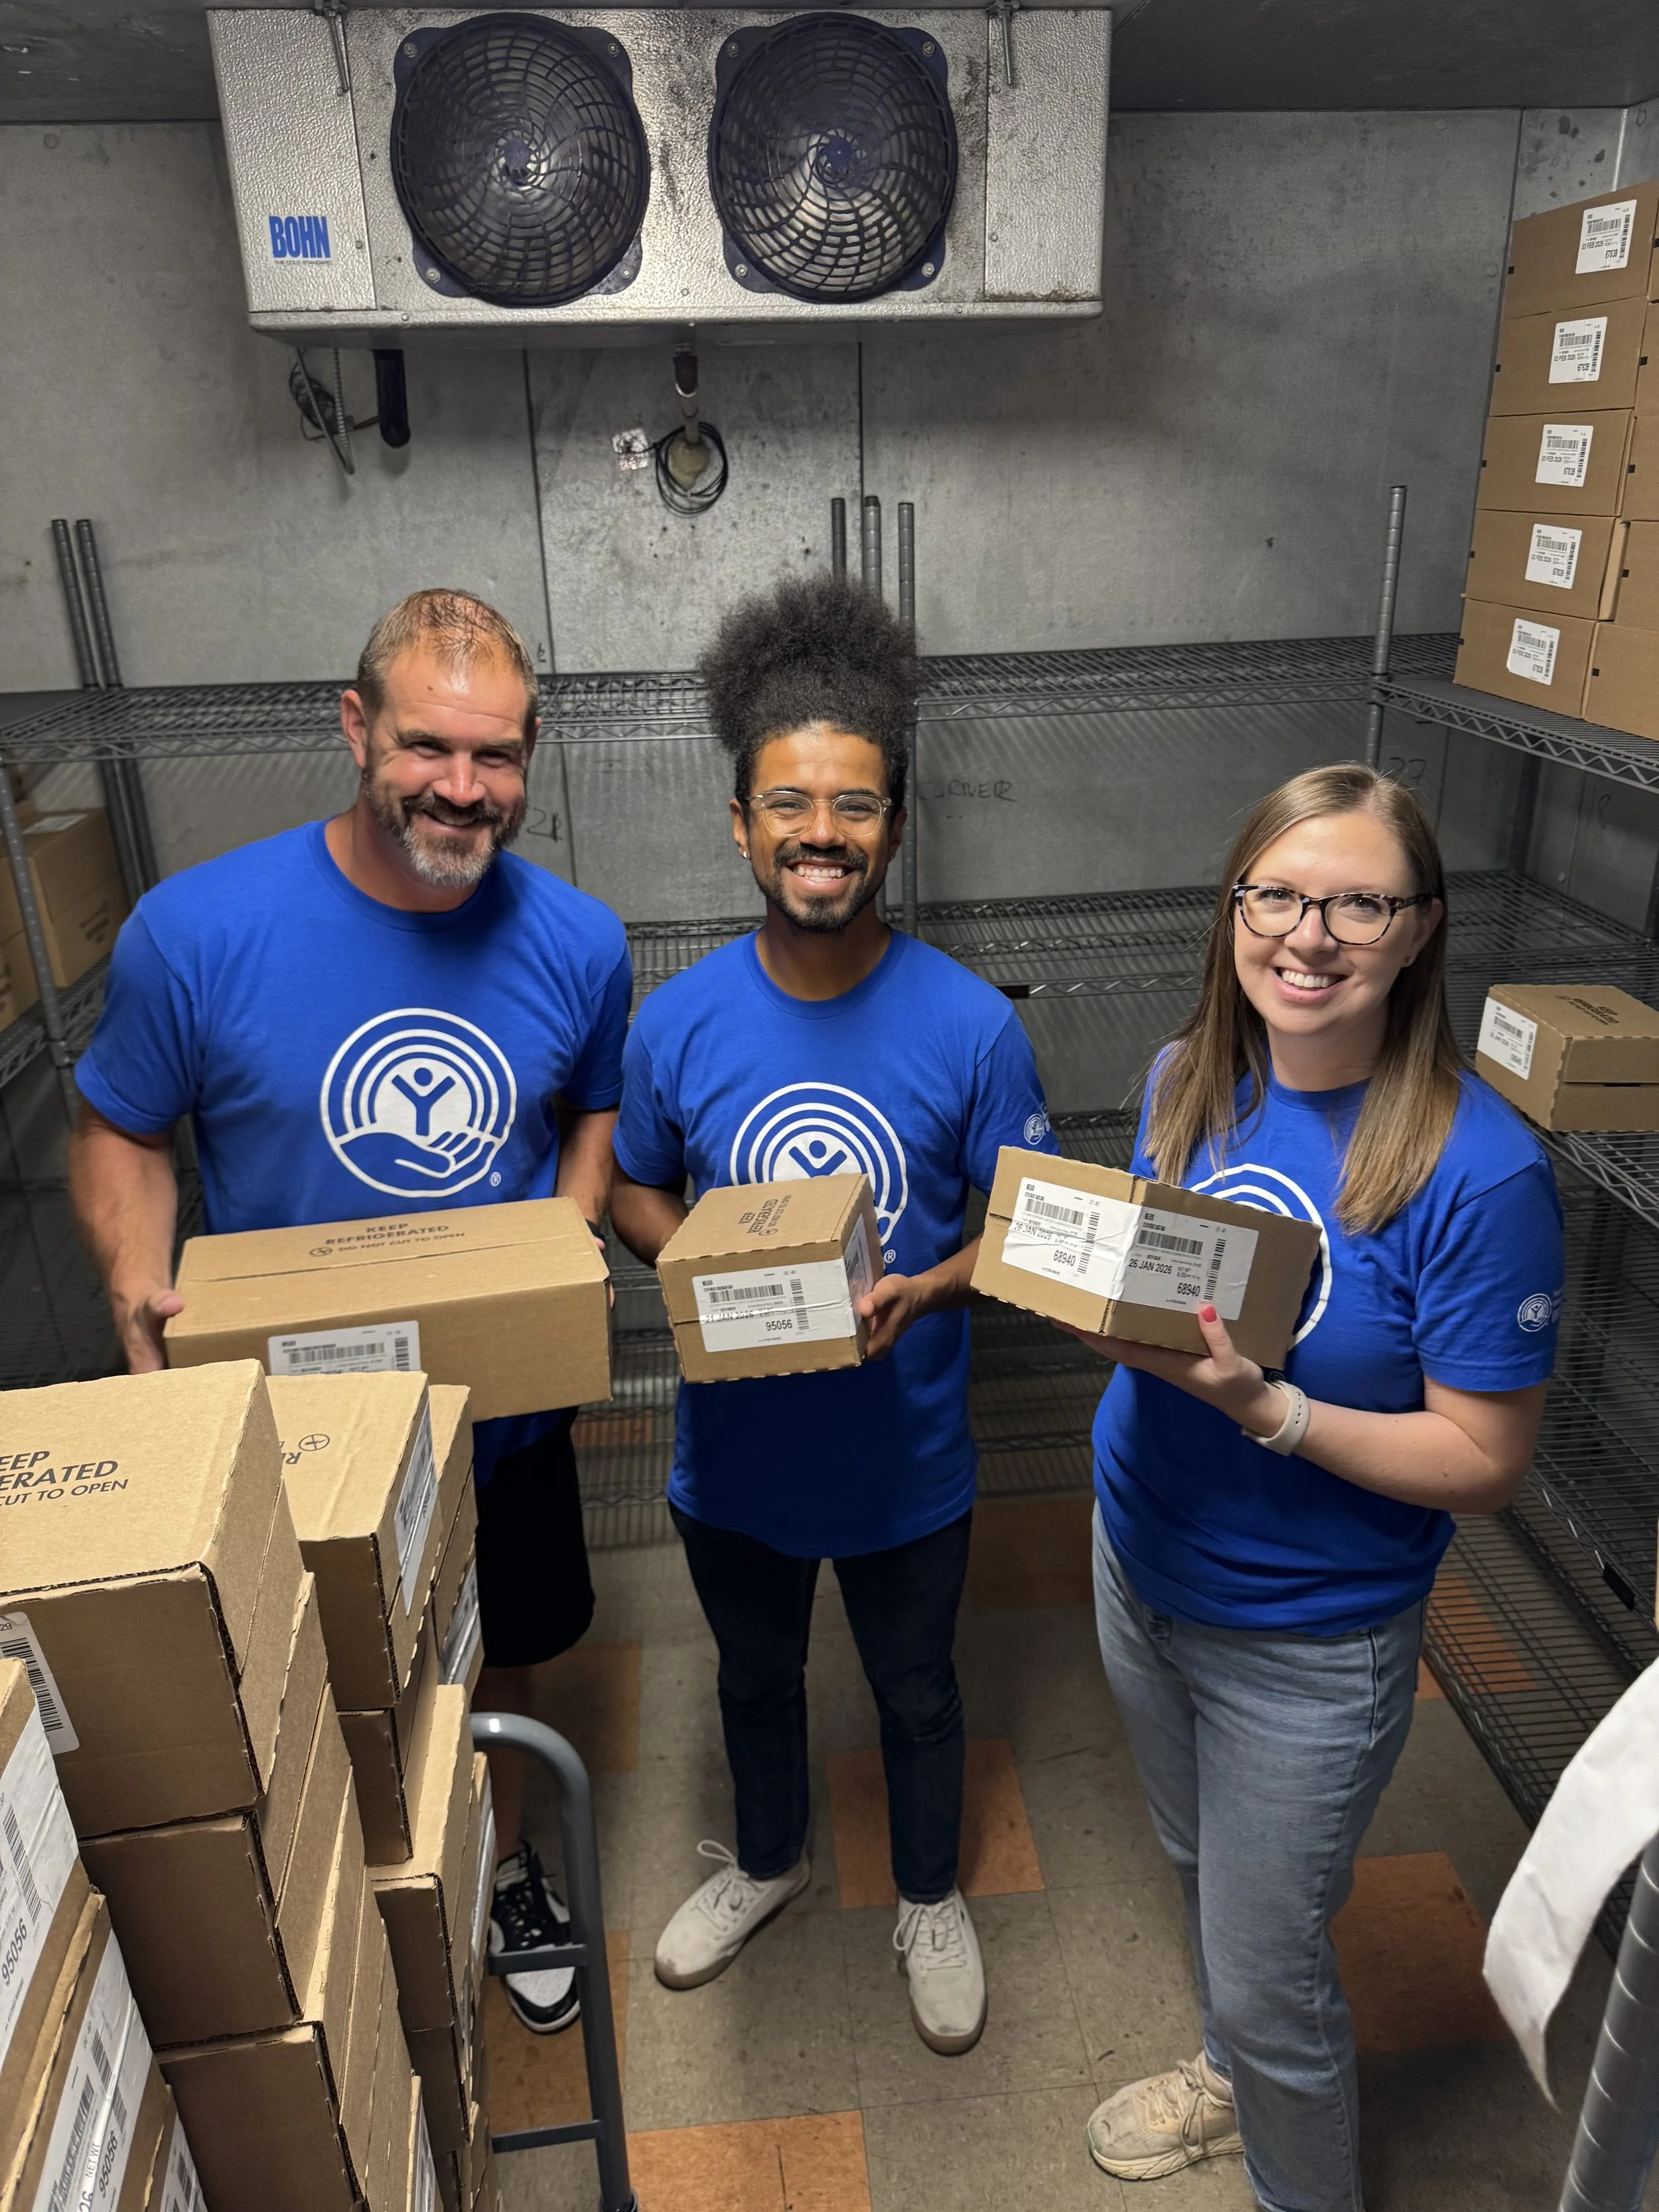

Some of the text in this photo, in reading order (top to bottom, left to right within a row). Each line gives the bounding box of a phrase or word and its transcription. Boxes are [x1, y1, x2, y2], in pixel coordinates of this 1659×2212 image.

[269, 216, 330, 258] BOHN
[738, 1212, 756, 1224] KEEP
[747, 1199, 778, 1233] REFRIGERATED
[325, 1225, 449, 1245] REFRIGERATED
[366, 1222, 409, 1233] KEEP
[1014, 1222, 1023, 1232] 26
[1023, 1224, 1037, 1236] JAN
[1037, 1229, 1053, 1240] 2026
[1053, 1250, 1076, 1267] 68940
[1129, 1258, 1173, 1274] 26 JAN 2026
[1177, 1282, 1200, 1297] 68940
[717, 1313, 733, 1322] JAN
[735, 1310, 754, 1319] 2026
[766, 1319, 793, 1331] 95056
[281, 1452, 302, 1465] R
[38, 1488, 65, 1501] TO
[70, 1479, 129, 1496] OPEN
[1, 1917, 27, 1986] 95056
[85, 2142, 100, 2178] NET WT
[100, 2130, 117, 2199] 95056
